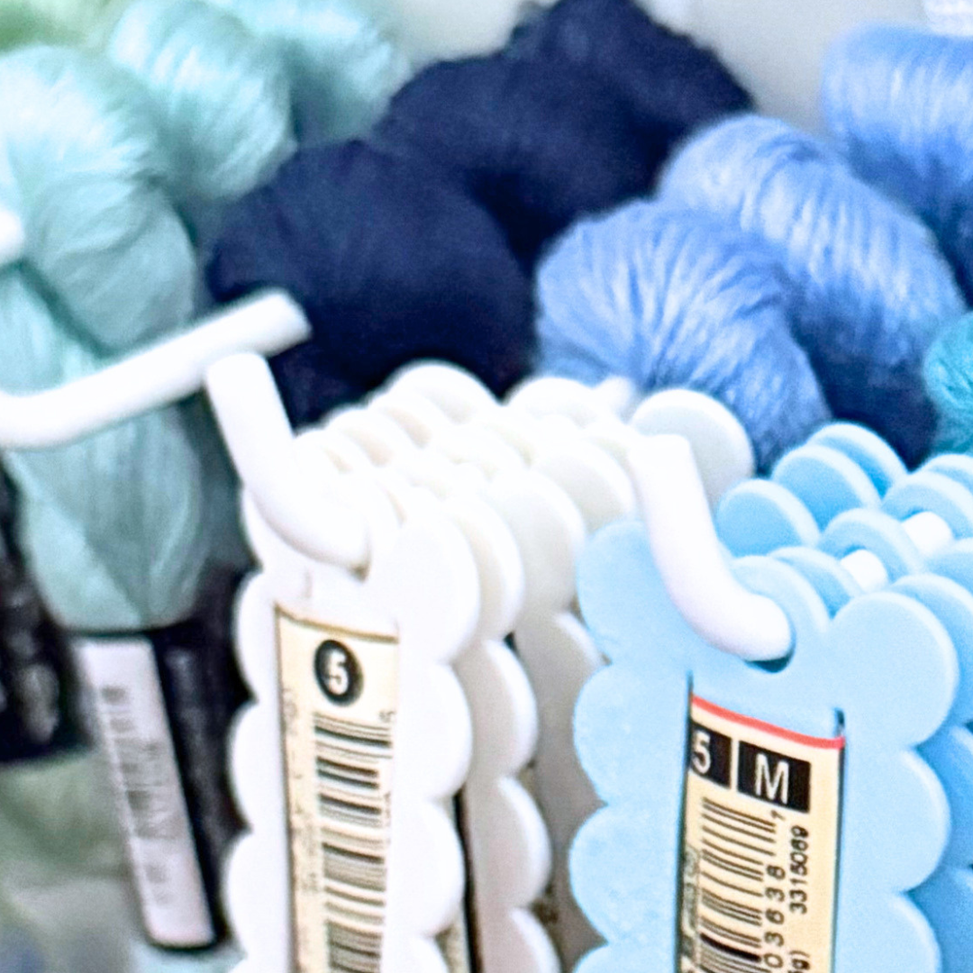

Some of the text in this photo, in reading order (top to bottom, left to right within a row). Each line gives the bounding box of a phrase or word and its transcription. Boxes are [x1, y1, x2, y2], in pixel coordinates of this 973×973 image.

[327, 648, 349, 696] 5
[691, 731, 790, 805] 5 M
